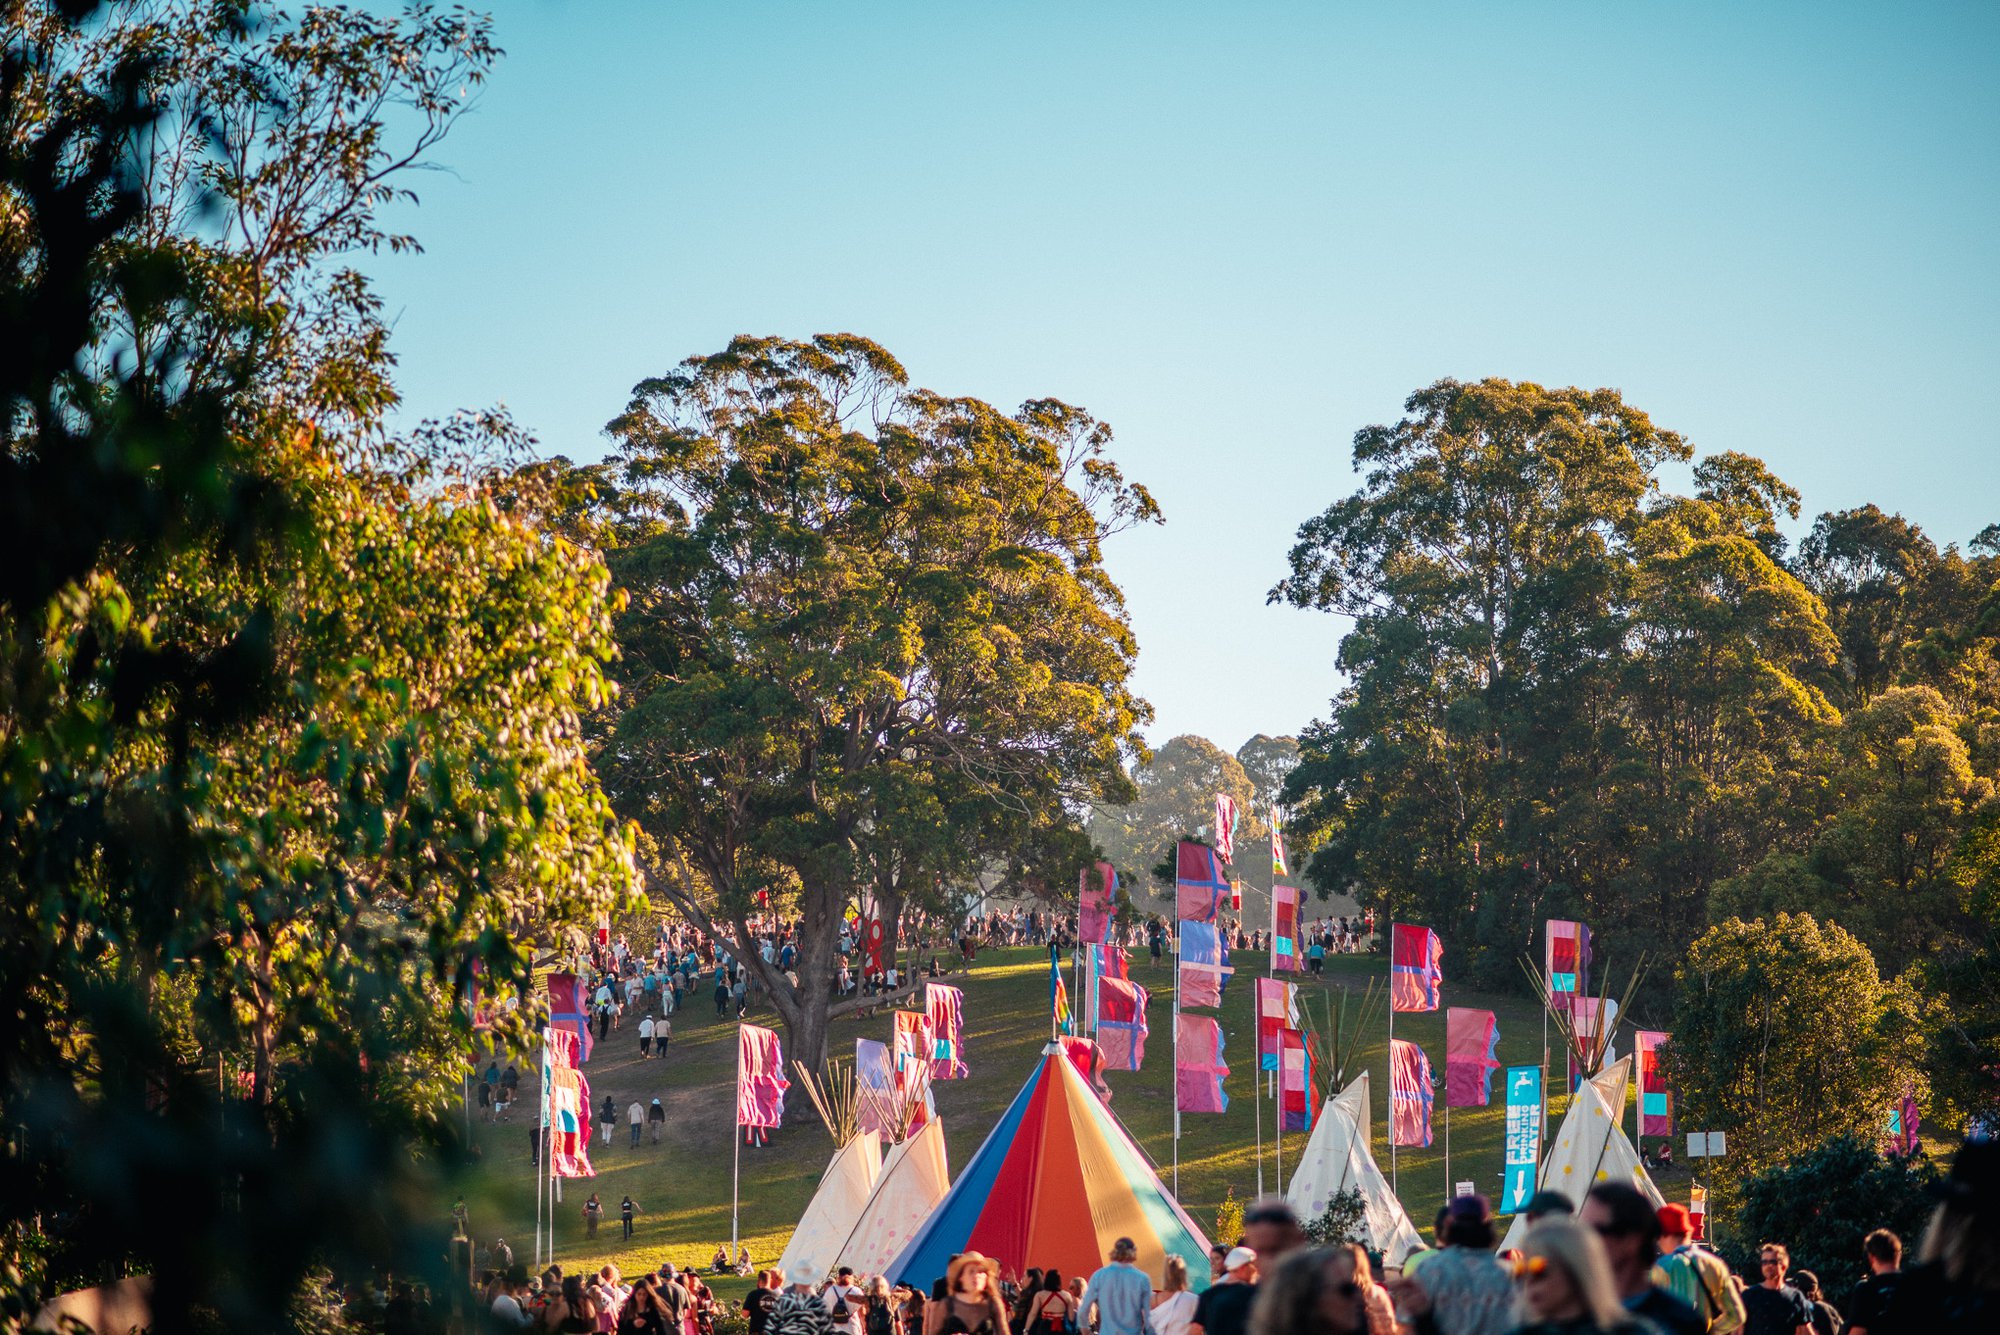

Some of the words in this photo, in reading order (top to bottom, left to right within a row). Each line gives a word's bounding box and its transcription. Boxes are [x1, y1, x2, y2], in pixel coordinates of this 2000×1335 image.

[1506, 1105, 1521, 1165] FREE
[1519, 1105, 1529, 1164] DRINKING
[1527, 1104, 1540, 1164] WATER
